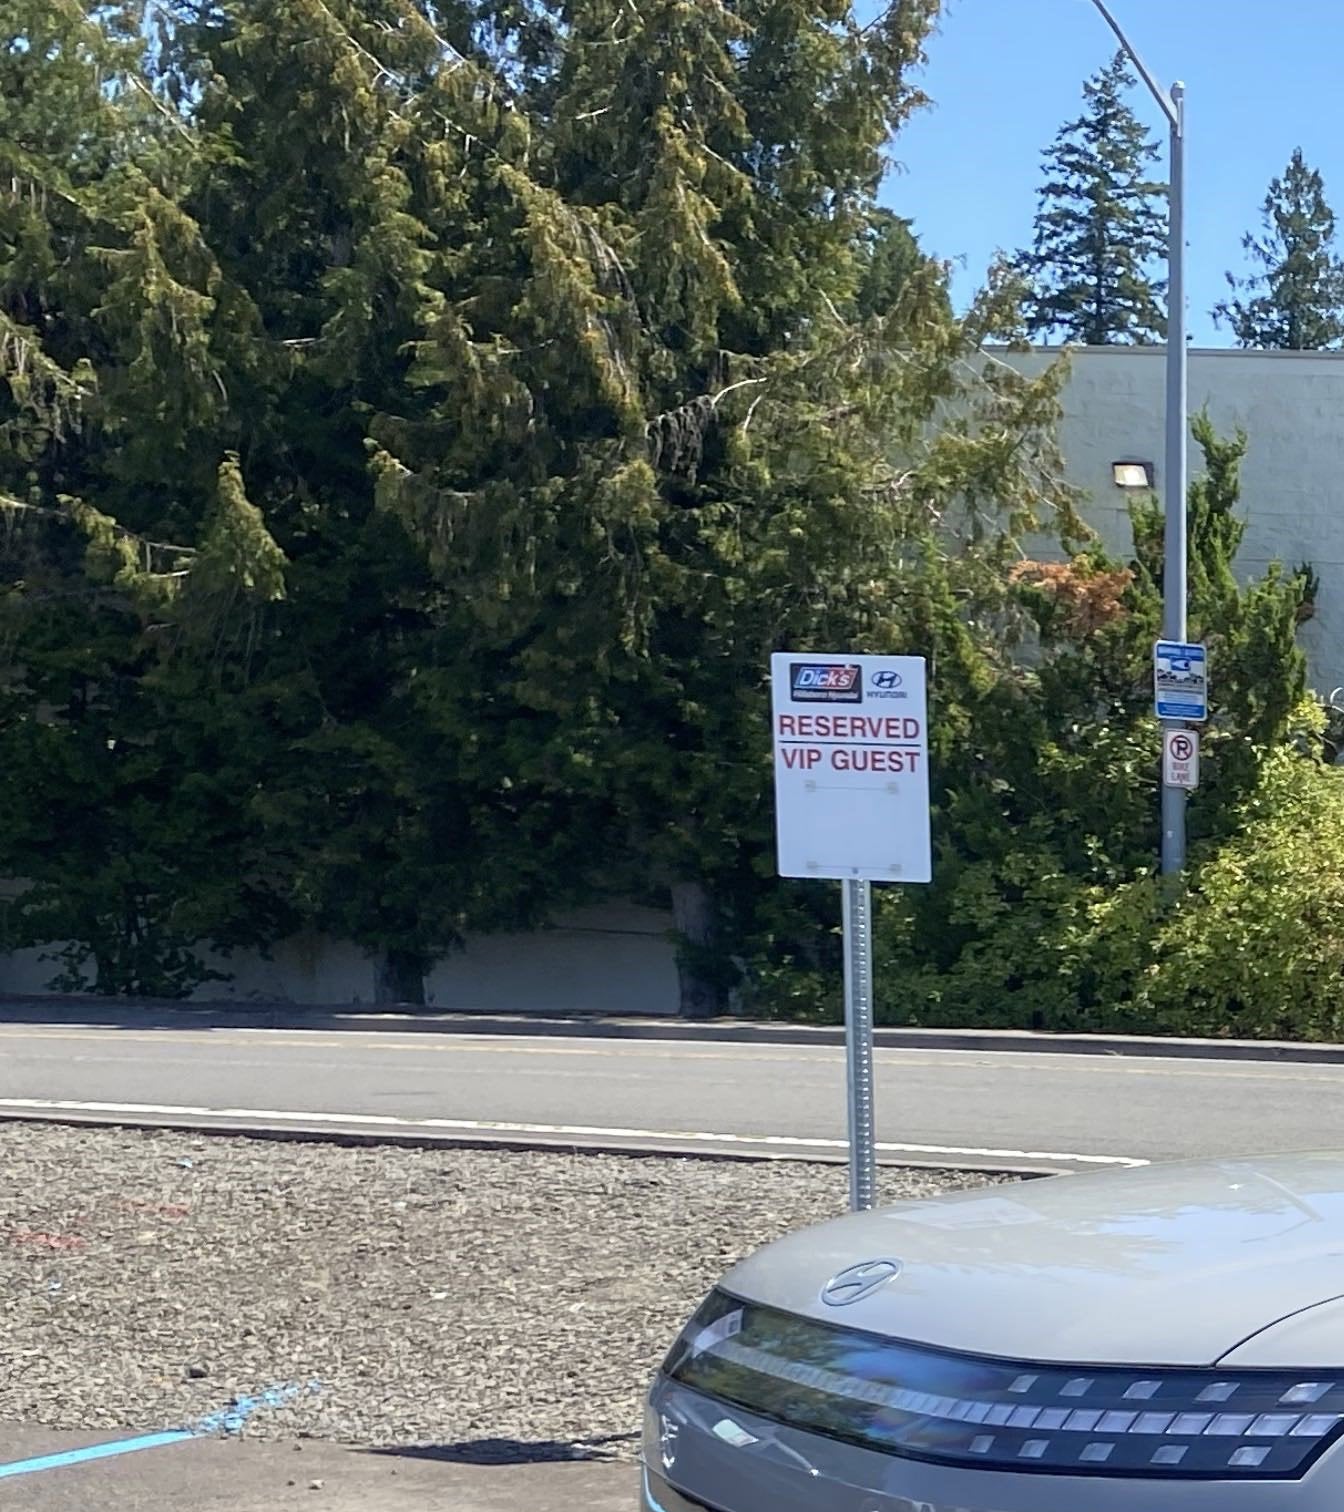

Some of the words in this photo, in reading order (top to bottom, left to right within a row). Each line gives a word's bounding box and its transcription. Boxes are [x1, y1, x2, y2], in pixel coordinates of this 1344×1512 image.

[799, 668, 851, 687] Dick's
[866, 691, 908, 699] HYUNDAI
[779, 715, 920, 739] RESERVED
[781, 749, 822, 769] VIP
[831, 750, 921, 772] GUEST
